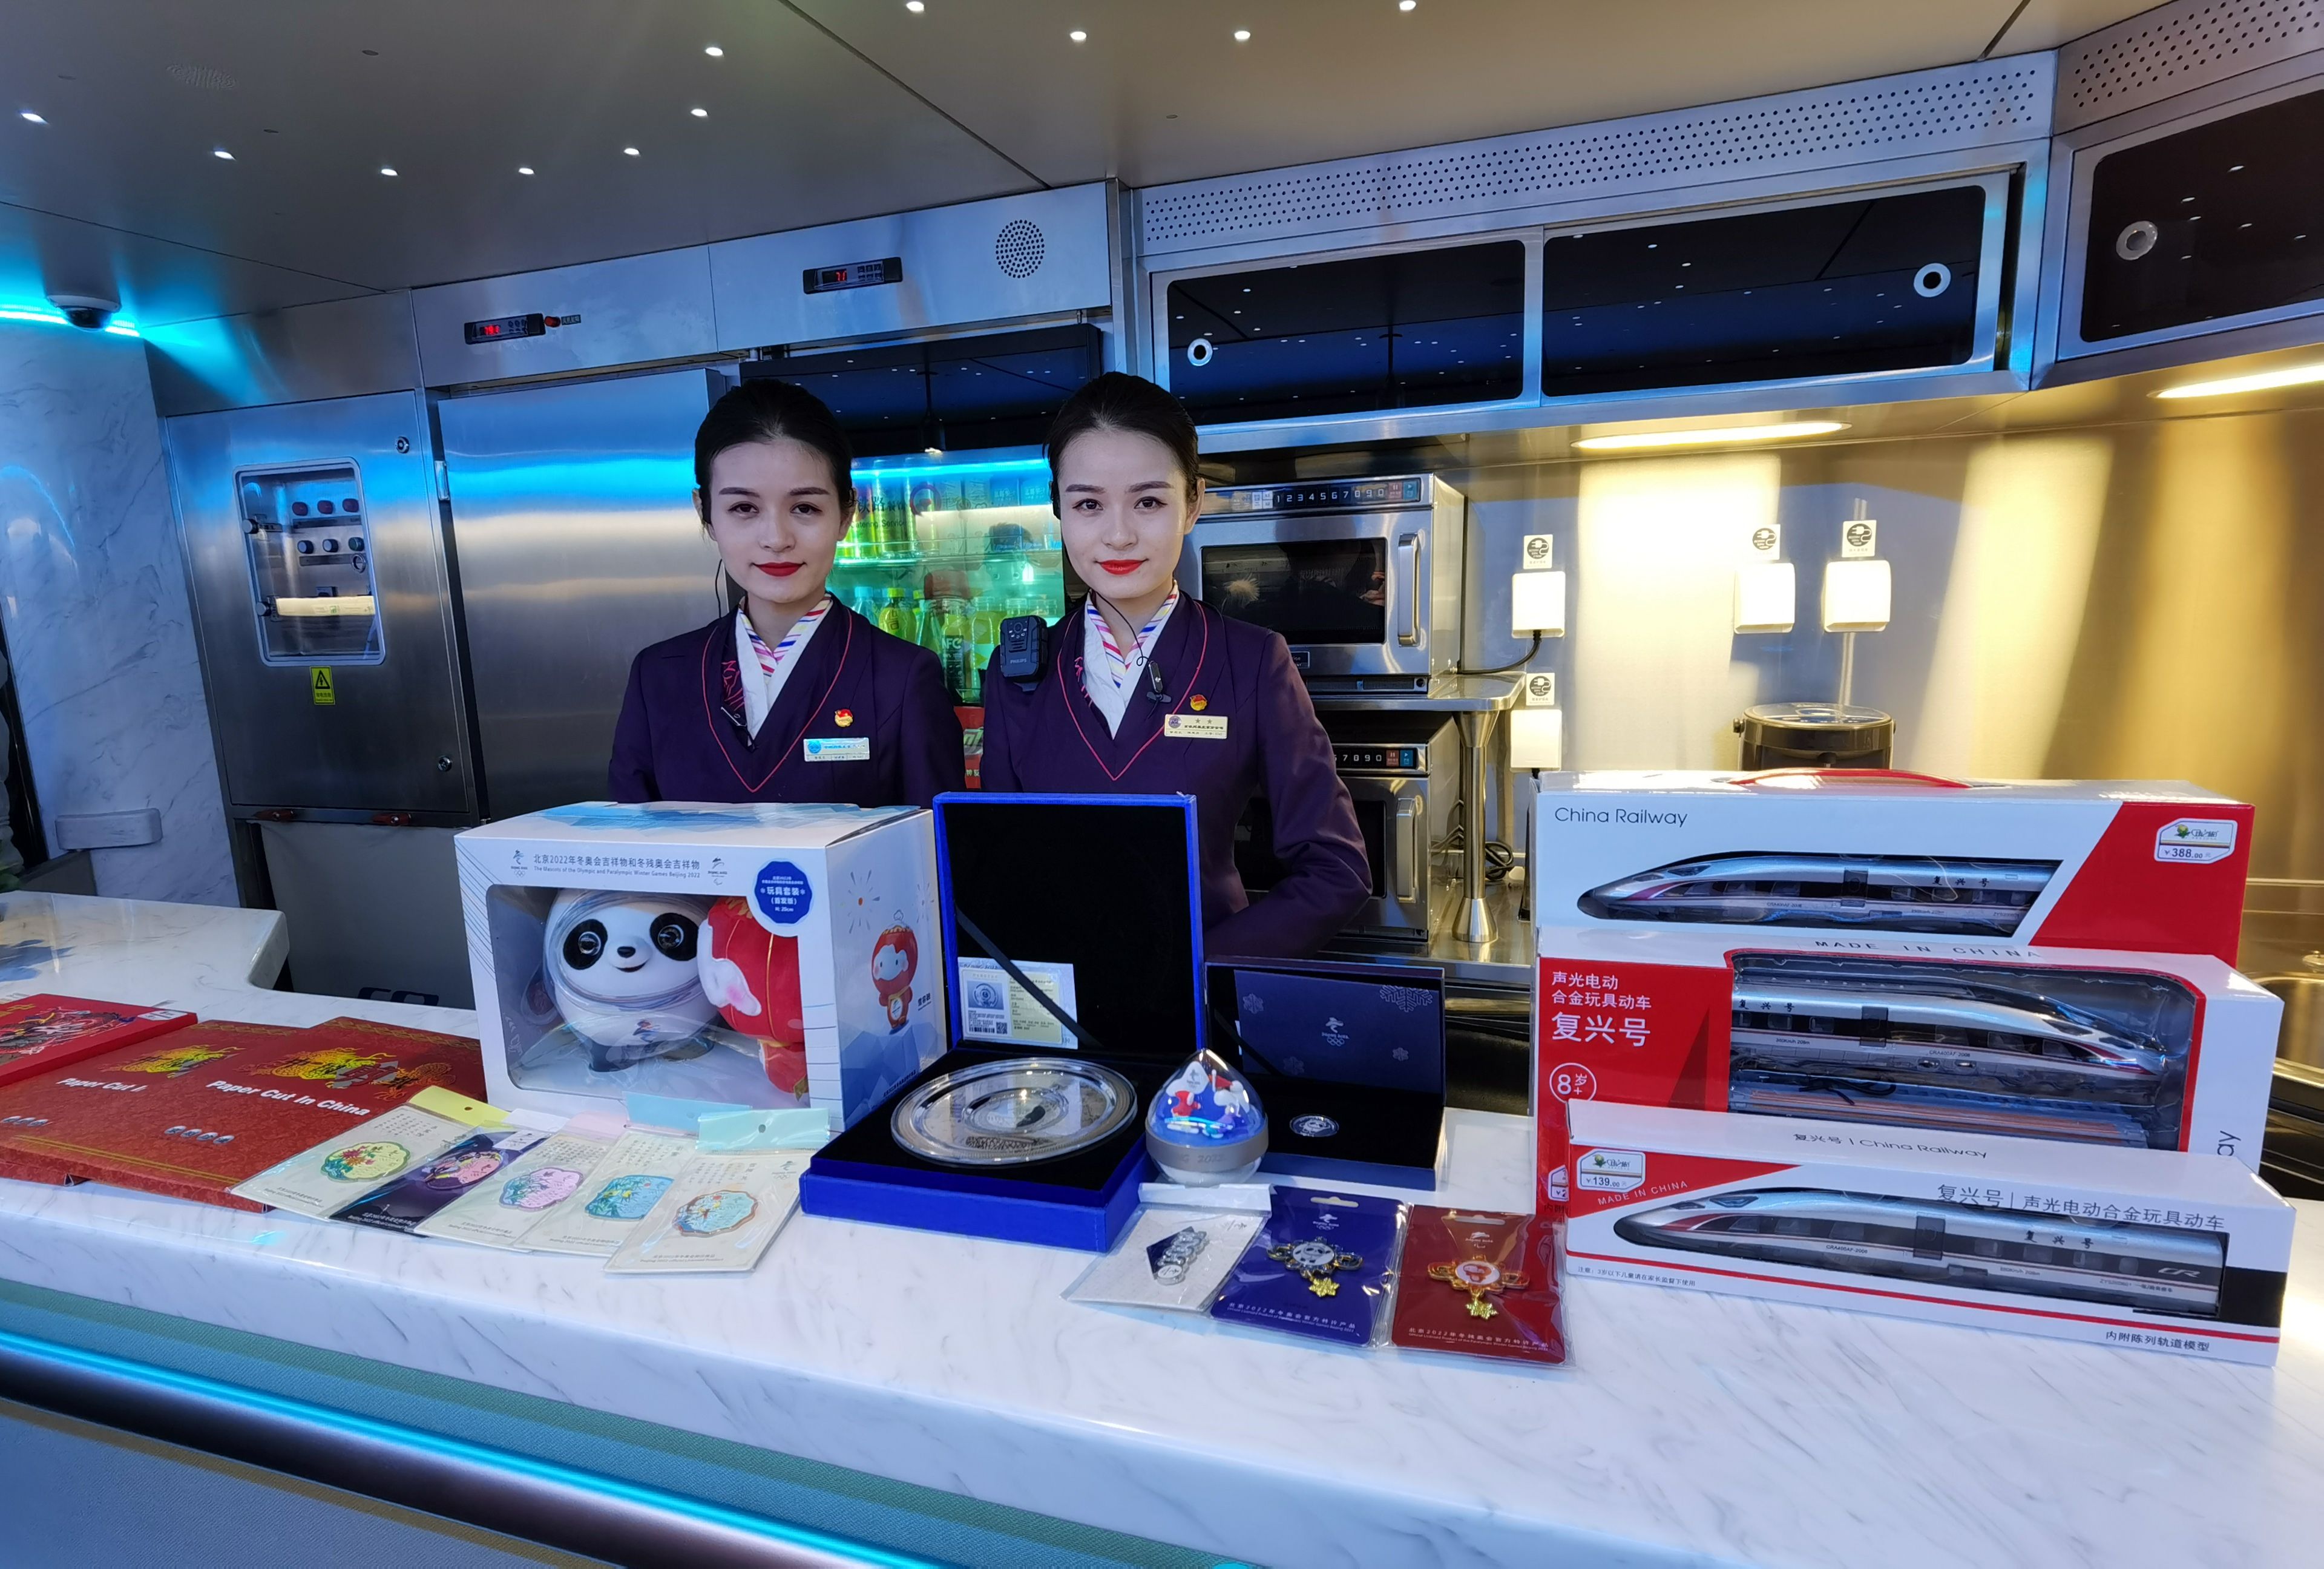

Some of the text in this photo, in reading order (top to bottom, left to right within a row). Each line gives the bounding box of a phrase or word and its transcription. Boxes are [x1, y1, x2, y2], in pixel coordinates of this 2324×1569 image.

[1366, 489, 1372, 498] 9
[1555, 807, 1688, 827] China Railway
[533, 854, 700, 870] 北京2022年冬奥会吉祥物和冬残奥会吉祥物
[1932, 875, 1990, 887] 复兴号
[1815, 941, 1879, 950] MADE
[1952, 947, 2042, 958] CHINA
[1552, 970, 1618, 990] 声光电动
[1552, 989, 1652, 1010] 合金玩具动车
[1738, 999, 1795, 1012] 复兴号
[1552, 1011, 1651, 1047] 复兴号
[56, 1077, 105, 1088] Paper
[102, 1082, 134, 1091] Cut
[206, 1080, 370, 1116] Paper Cut In China
[1793, 1133, 1842, 1145] 复兴号
[1860, 1139, 1987, 1159] China Railway
[1598, 1180, 1688, 1206] MADE IN CHINA
[1937, 1183, 2004, 1208] 复兴号
[2023, 1194, 2225, 1232] 声光电动合金玩具动车
[2024, 1229, 2094, 1249] 复兴号
[2106, 1331, 2210, 1352] 内附陈列轨道模型
